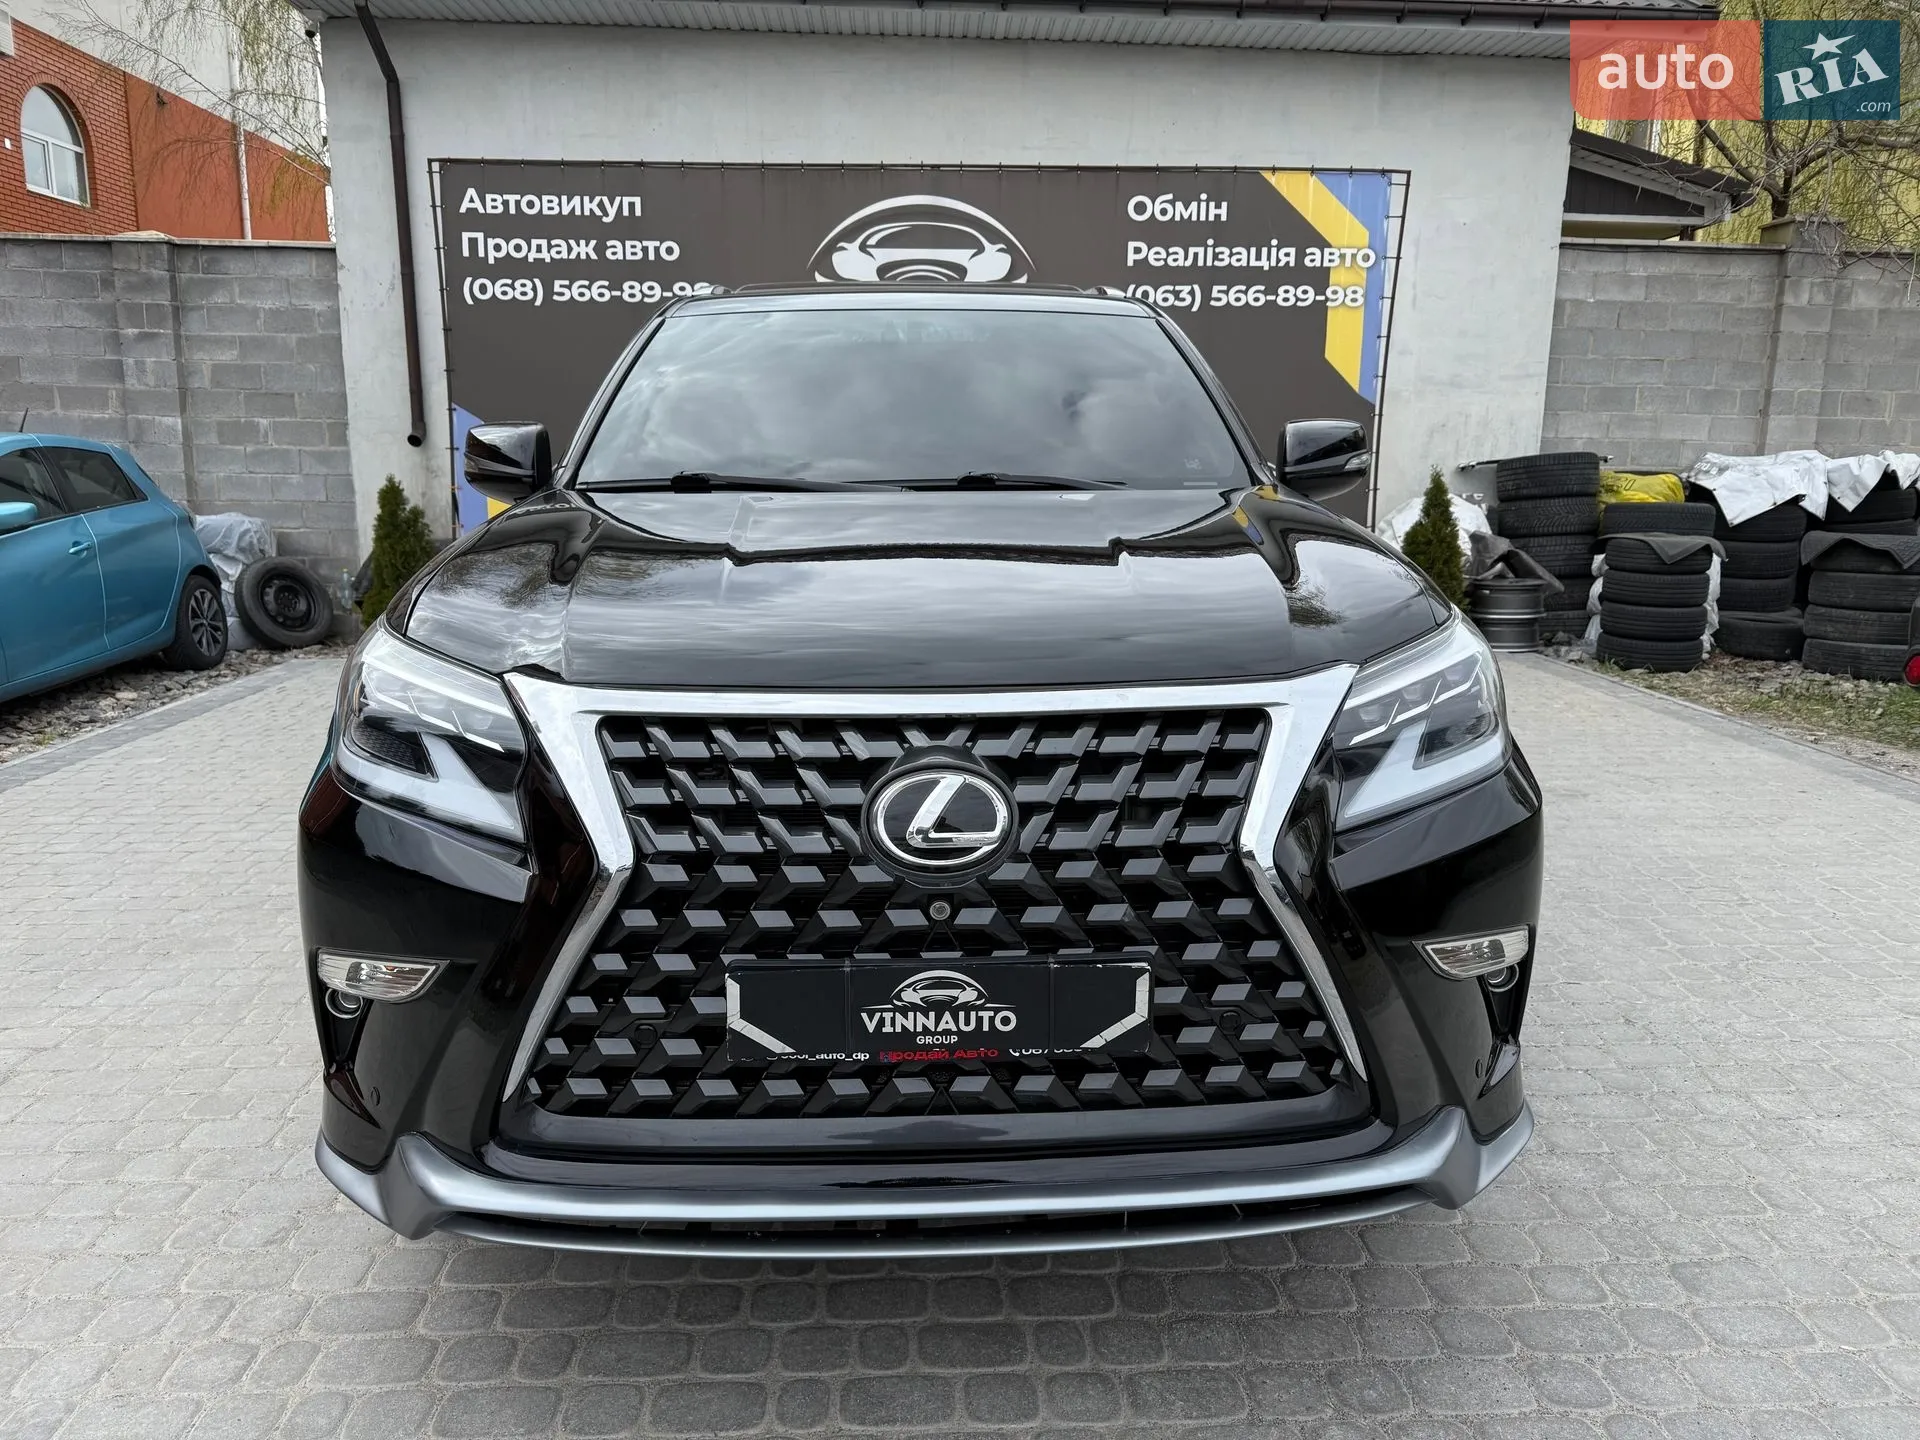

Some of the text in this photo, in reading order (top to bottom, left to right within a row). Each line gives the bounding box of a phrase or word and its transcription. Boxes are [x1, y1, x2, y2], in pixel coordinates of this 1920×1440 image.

[459, 187, 642, 223] Автовикуп
[1127, 193, 1228, 222] Обмін
[461, 231, 681, 264] Продаж авто
[1126, 238, 1377, 271] Реалізація авто
[462, 276, 544, 307] (068)
[1126, 284, 1365, 312] (063) 566-89-98
[860, 1010, 1018, 1034] VINNAUTO
[916, 1035, 958, 1045] GROUP
[953, 1048, 999, 1060] Авто
